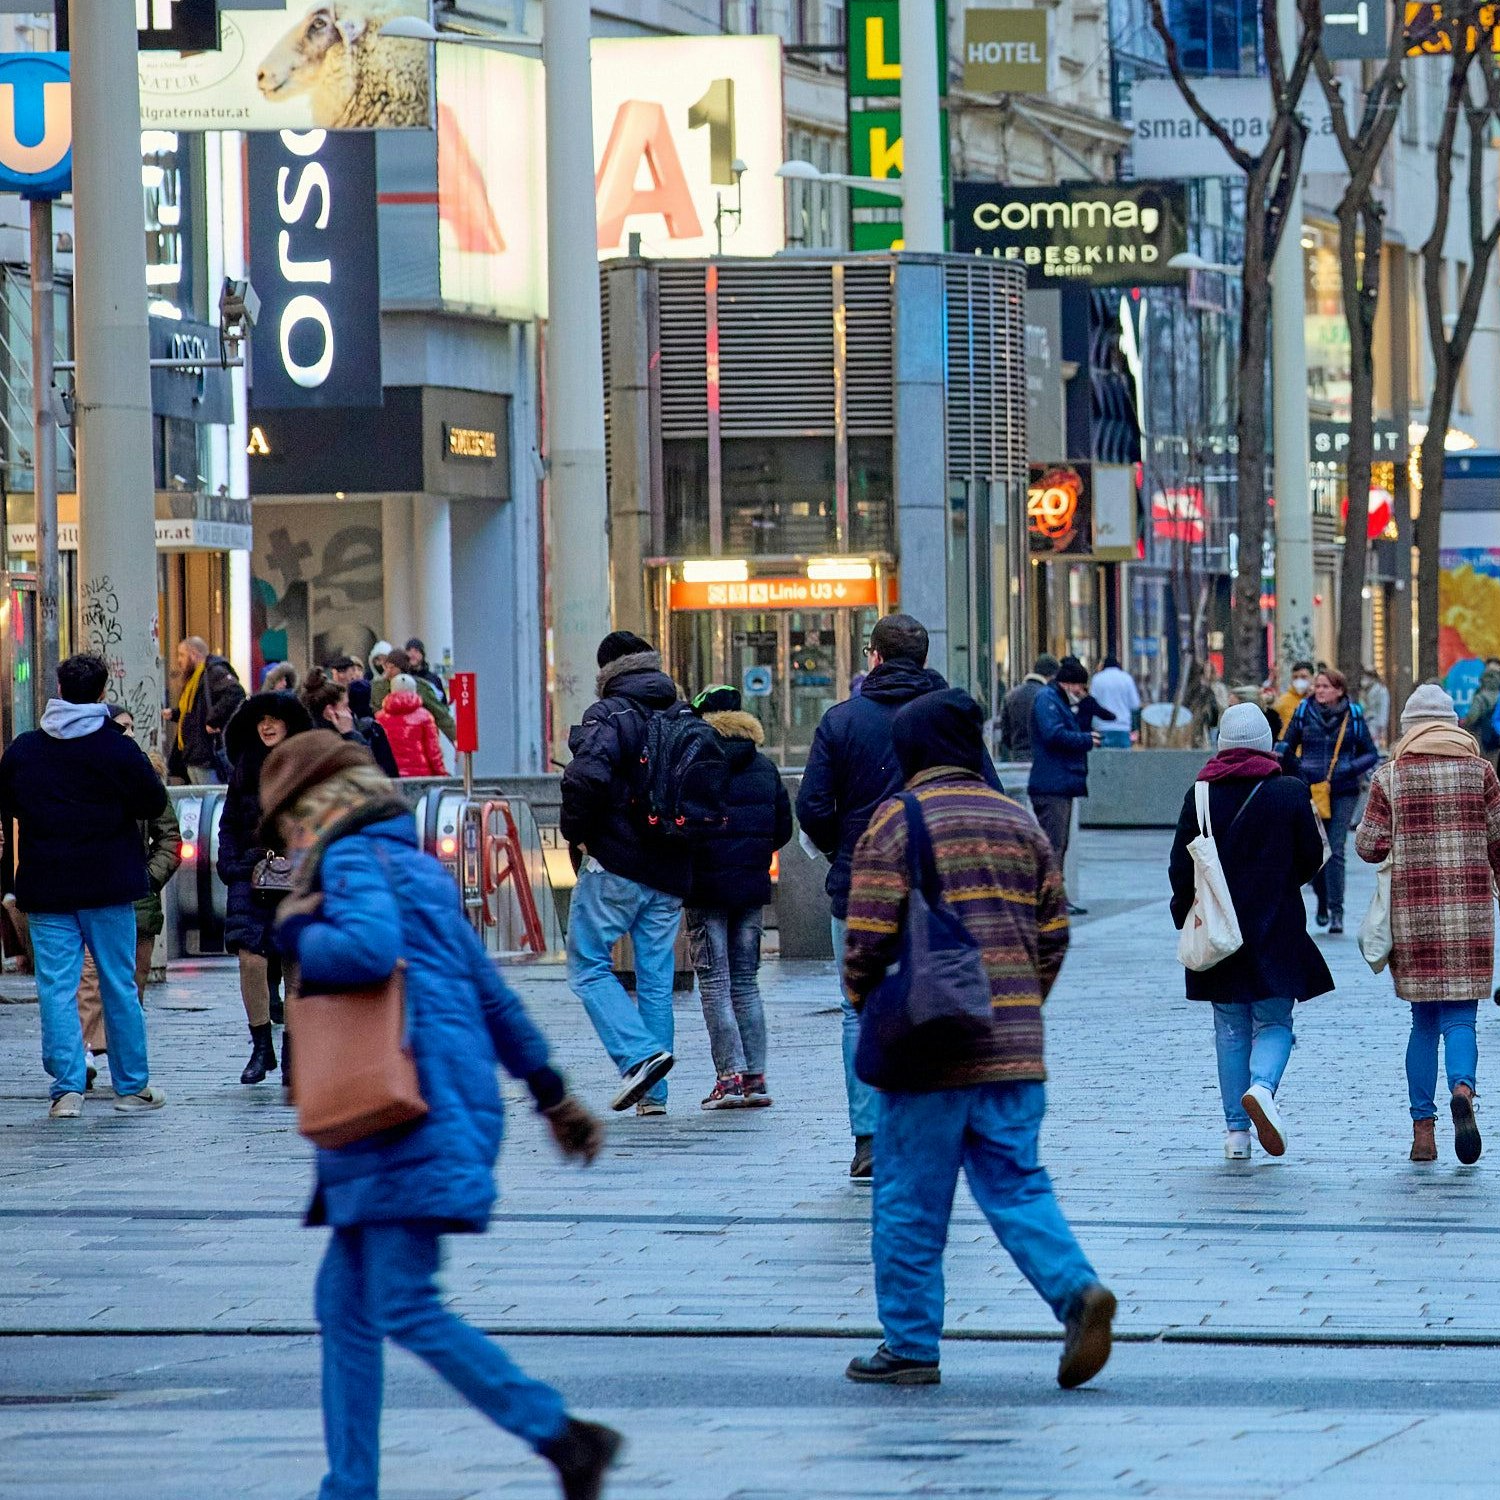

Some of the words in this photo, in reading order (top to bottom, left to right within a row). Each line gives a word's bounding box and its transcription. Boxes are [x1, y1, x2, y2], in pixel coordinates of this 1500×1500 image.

[968, 43, 1041, 64] HOTEL
[0, 83, 72, 174] U
[973, 200, 1159, 234] comma,
[1044, 263, 1093, 277] Berlin
[1315, 432, 1400, 453] SPIT
[770, 583, 807, 600] Linie
[810, 583, 832, 599] U3
[461, 675, 469, 706] STOP
